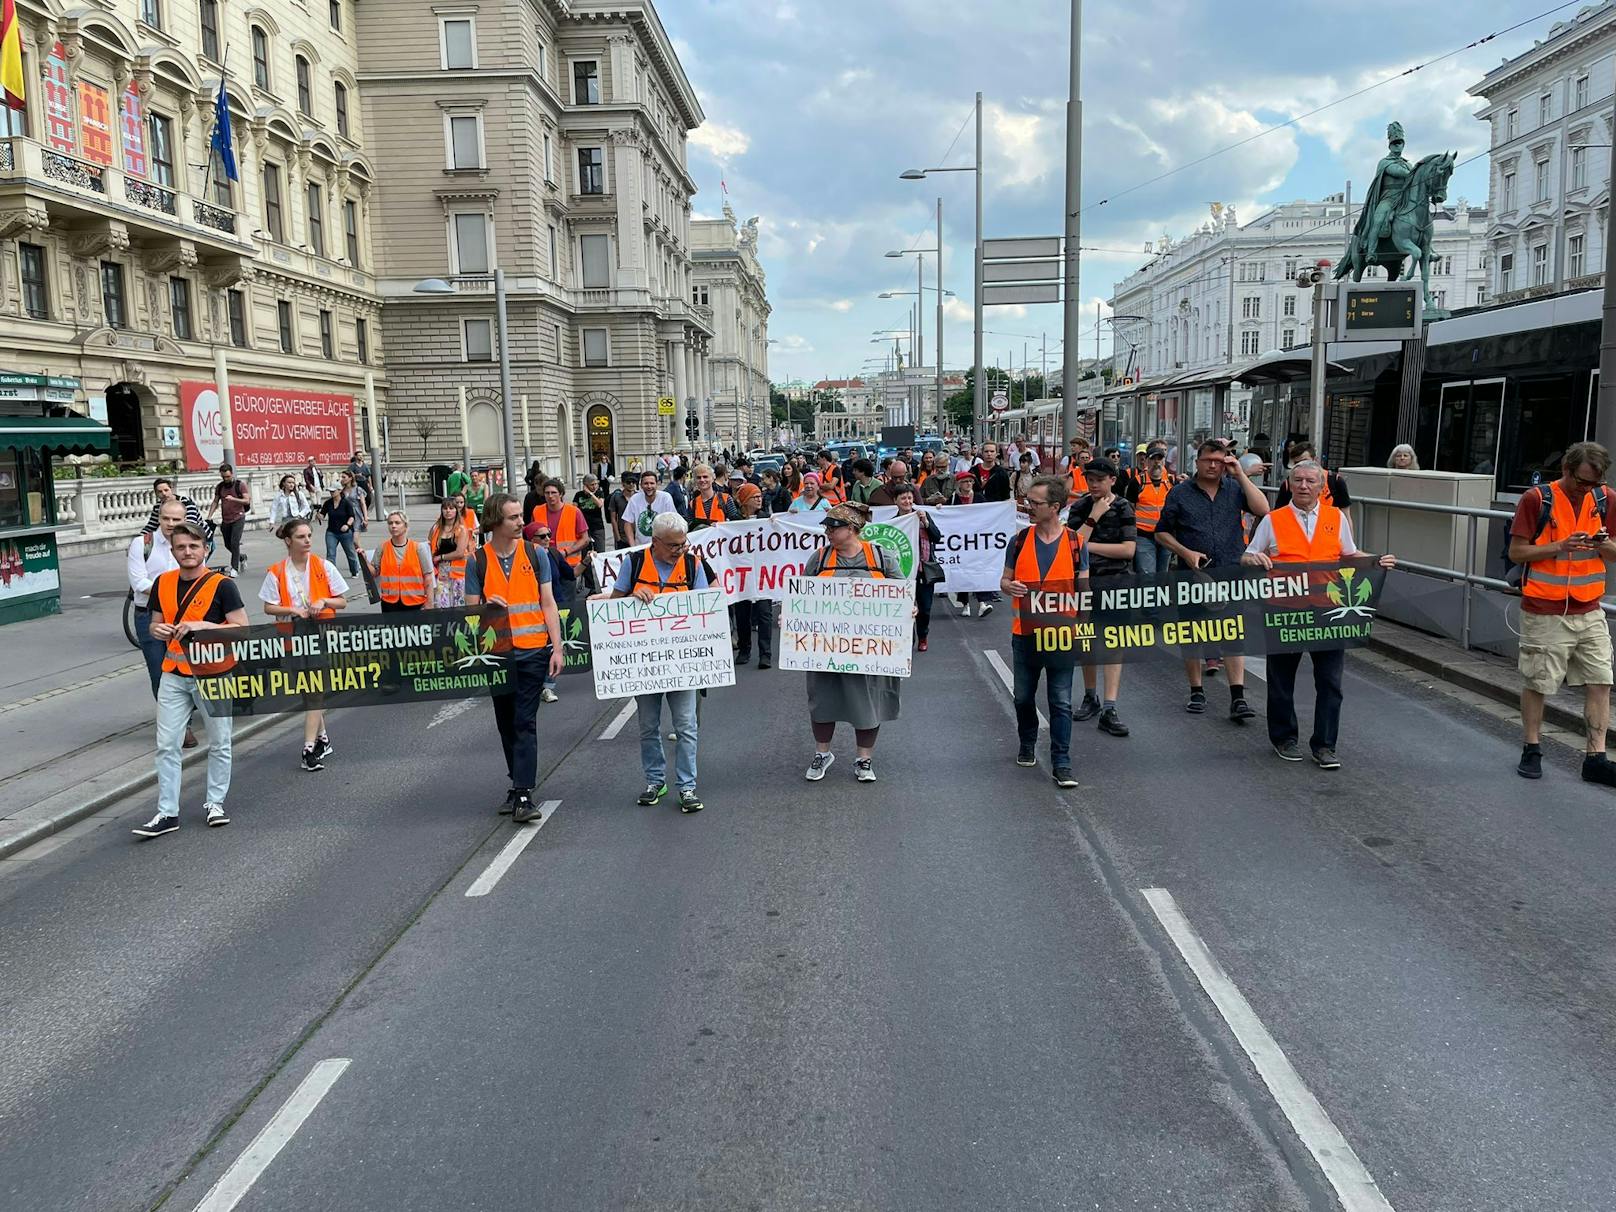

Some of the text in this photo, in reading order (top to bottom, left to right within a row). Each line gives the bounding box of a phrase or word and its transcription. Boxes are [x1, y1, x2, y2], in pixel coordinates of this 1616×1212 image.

[234, 393, 350, 417] BÜRO/GEWERBEFLÄCHE
[271, 425, 285, 440] ZU
[286, 425, 339, 440] VERMIETEN.
[247, 452, 259, 464] +43
[260, 452, 273, 464] 699
[285, 451, 296, 463] 387
[690, 526, 826, 561] nerationen
[860, 526, 912, 558] FOR FUTURE
[717, 563, 807, 595] CT NO
[788, 578, 905, 599] NUR MIT ECHTEM
[1030, 571, 1310, 614] KEINE NEUEN BOHRUNGEN!
[591, 590, 723, 623] KLIMASCHUTZ
[791, 599, 904, 618] KLIMASCHUTZ
[607, 611, 716, 637] JETZT
[786, 618, 902, 638] KÖNNEN WIR UNSEREN
[1265, 611, 1315, 628] LETZTE
[1033, 625, 1073, 653] 100
[1104, 623, 1156, 649] SIND
[1162, 614, 1245, 646] GENUG!
[188, 641, 225, 666] UND
[231, 637, 286, 662] WENN
[291, 633, 321, 657] DIE
[326, 624, 433, 654] REGIERUNG
[641, 648, 675, 663] MEHR
[399, 660, 445, 677] LETZTE
[596, 668, 633, 681] UNSERE
[786, 657, 797, 668] in
[802, 656, 823, 670] die
[826, 656, 859, 673] Augen
[194, 661, 382, 701] KEINEN PLAN HAT?
[413, 669, 508, 693] GENERATION.AT
[688, 671, 733, 688] ZUKUNFT
